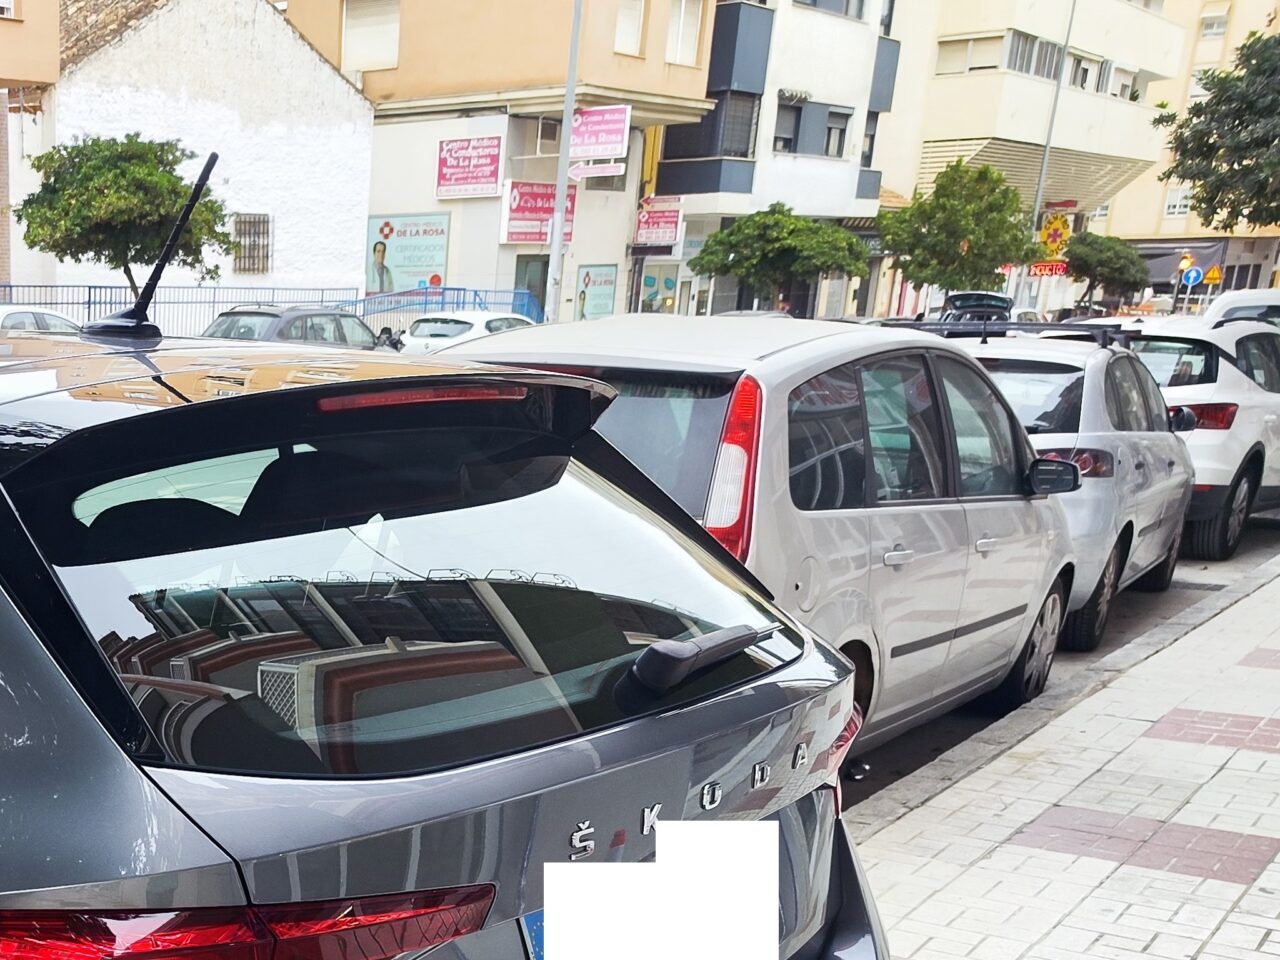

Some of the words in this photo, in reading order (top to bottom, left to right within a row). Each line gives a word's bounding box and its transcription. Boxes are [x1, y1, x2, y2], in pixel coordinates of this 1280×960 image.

[570, 135, 582, 144] De
[583, 133, 597, 144] La
[598, 132, 622, 143] Rosa
[442, 141, 470, 150] Centro
[447, 157, 458, 167] De
[1044, 213, 1070, 230] CENTRO
[396, 229, 408, 238] DE
[409, 229, 421, 237] LA
[422, 228, 445, 237] ROSA
[568, 742, 809, 861] ŠKODA
